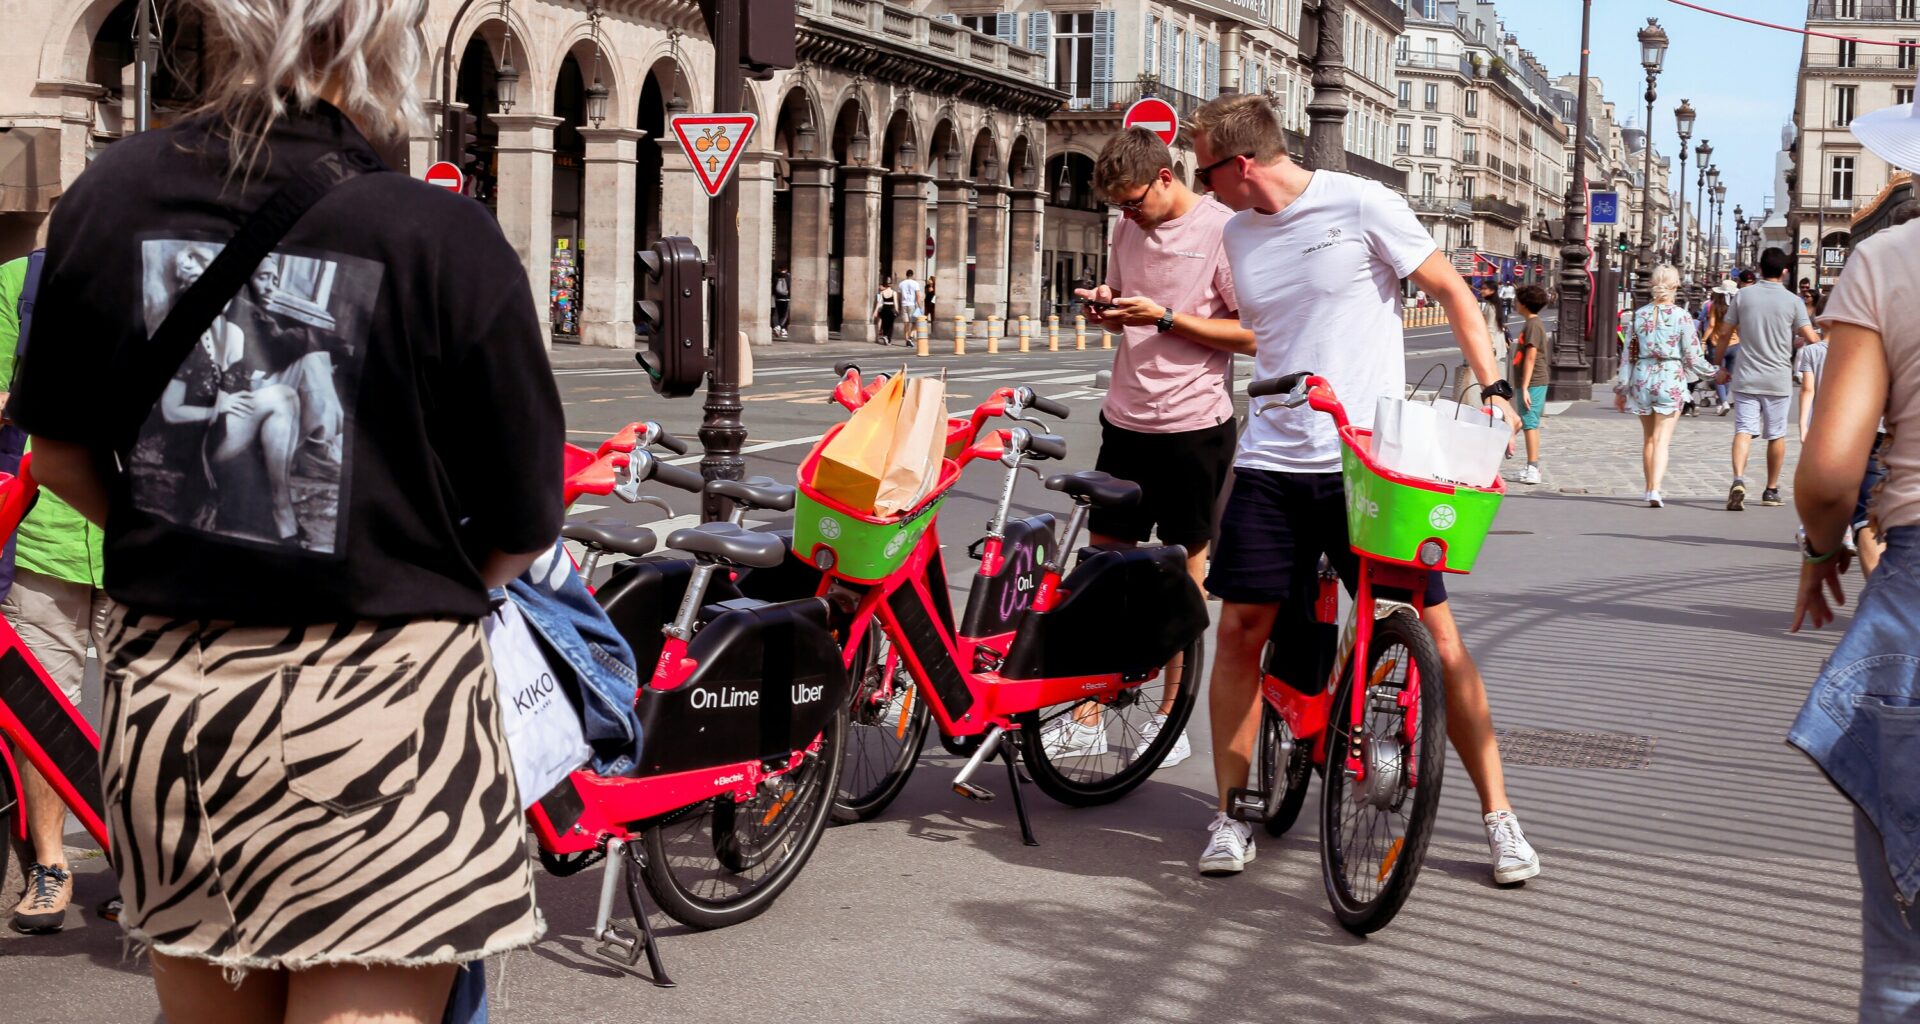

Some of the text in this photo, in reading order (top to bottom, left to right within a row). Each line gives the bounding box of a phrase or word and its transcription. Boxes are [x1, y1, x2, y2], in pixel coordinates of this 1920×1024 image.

[512, 672, 554, 716] KIKO
[690, 683, 824, 709] On Lime Uber
